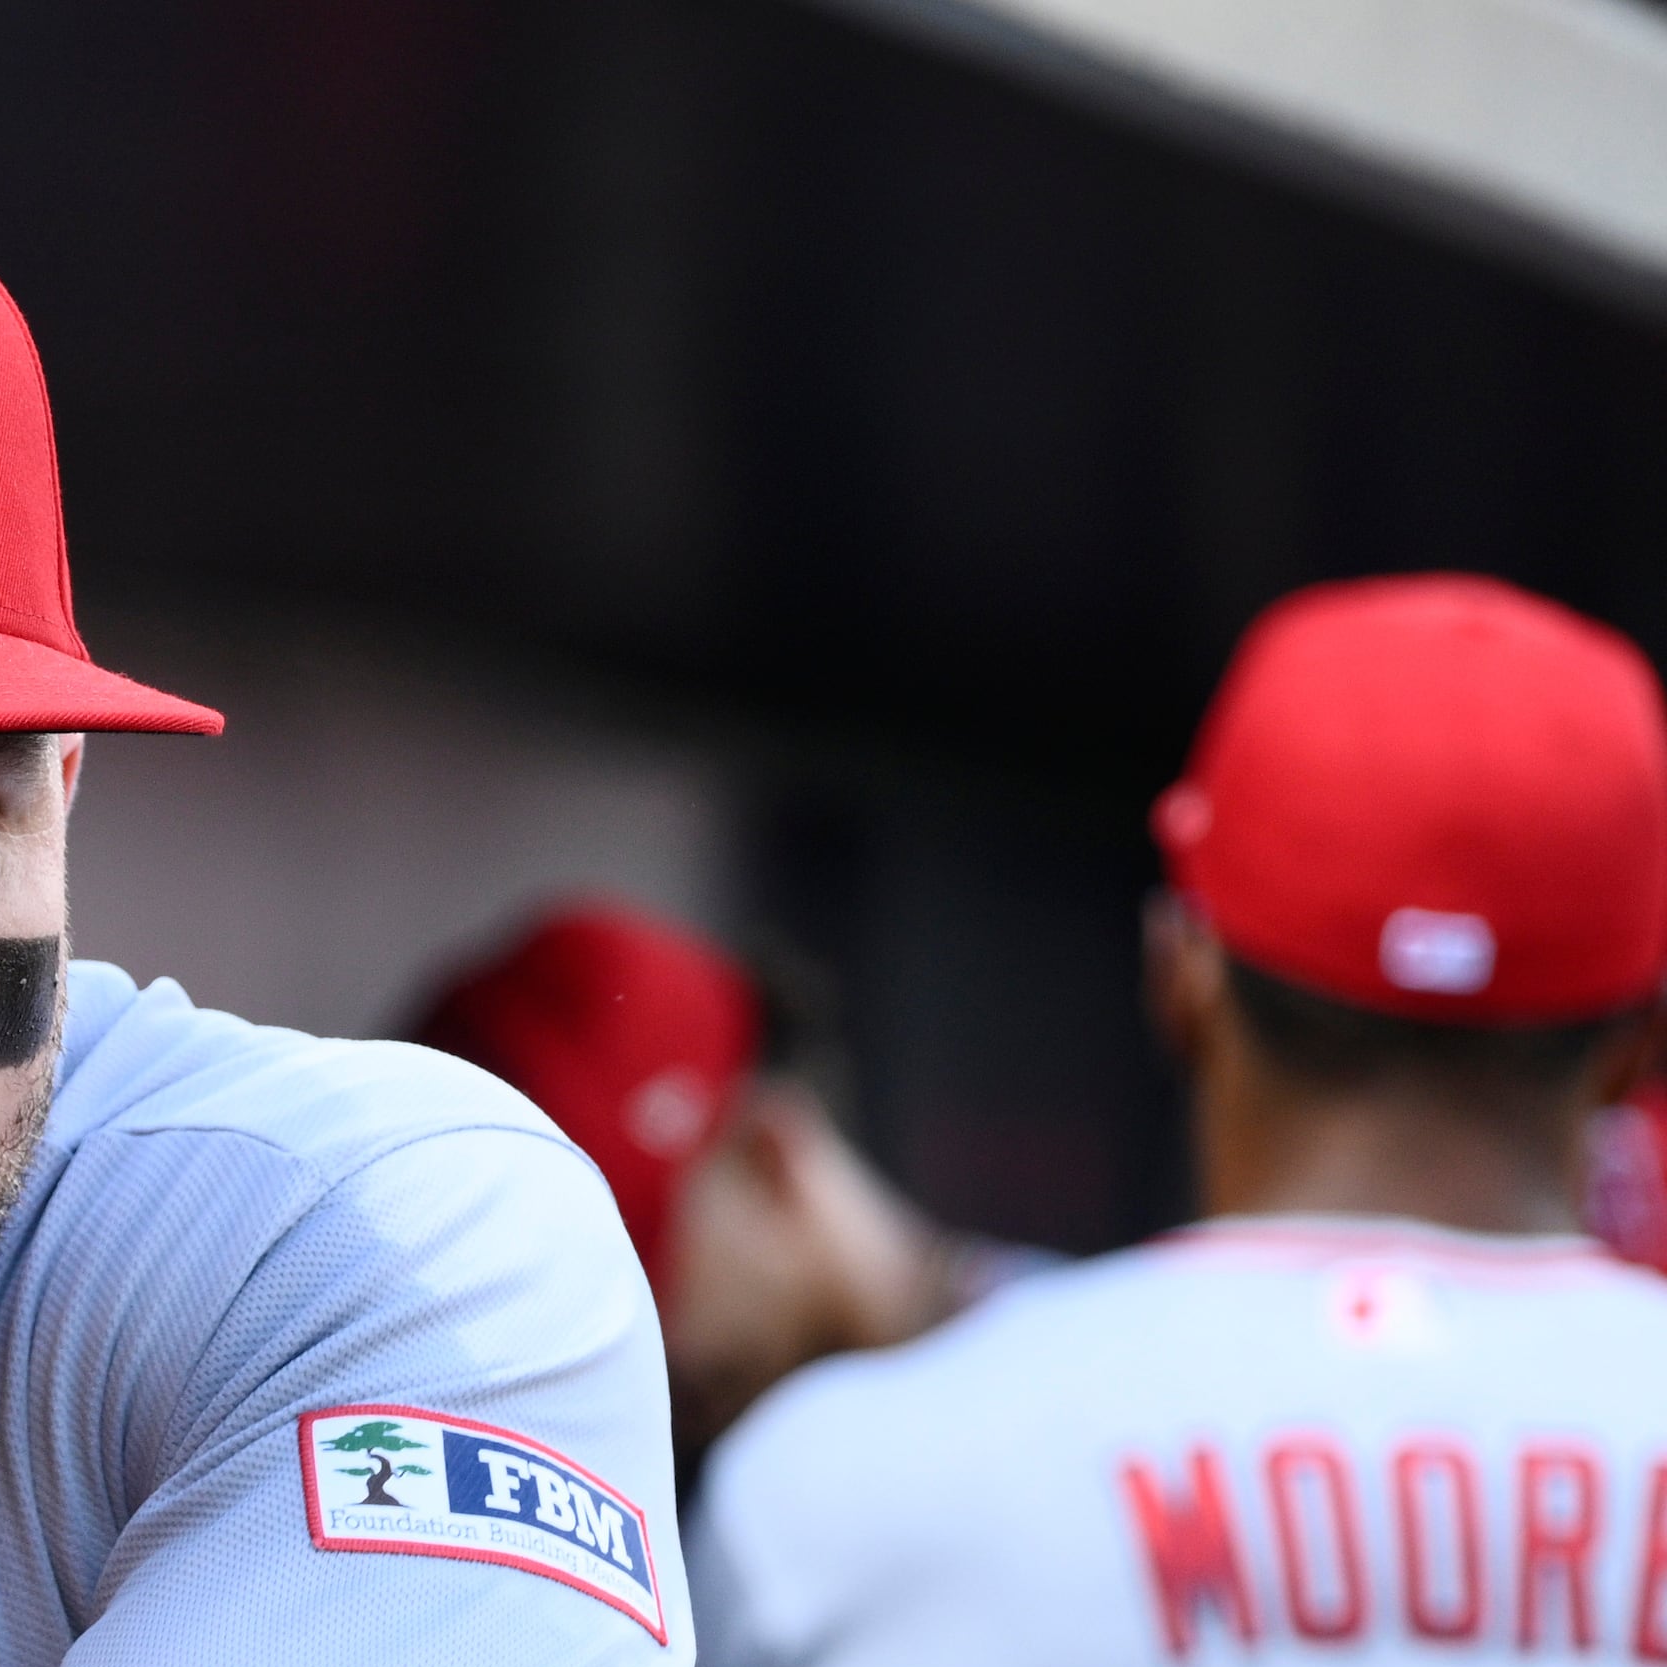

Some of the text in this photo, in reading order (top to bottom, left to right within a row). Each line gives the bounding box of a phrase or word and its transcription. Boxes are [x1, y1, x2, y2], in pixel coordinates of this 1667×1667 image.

[330, 1508, 478, 1541] Foundation
[490, 1522, 578, 1574] Building
[477, 1449, 633, 1571] FBM
